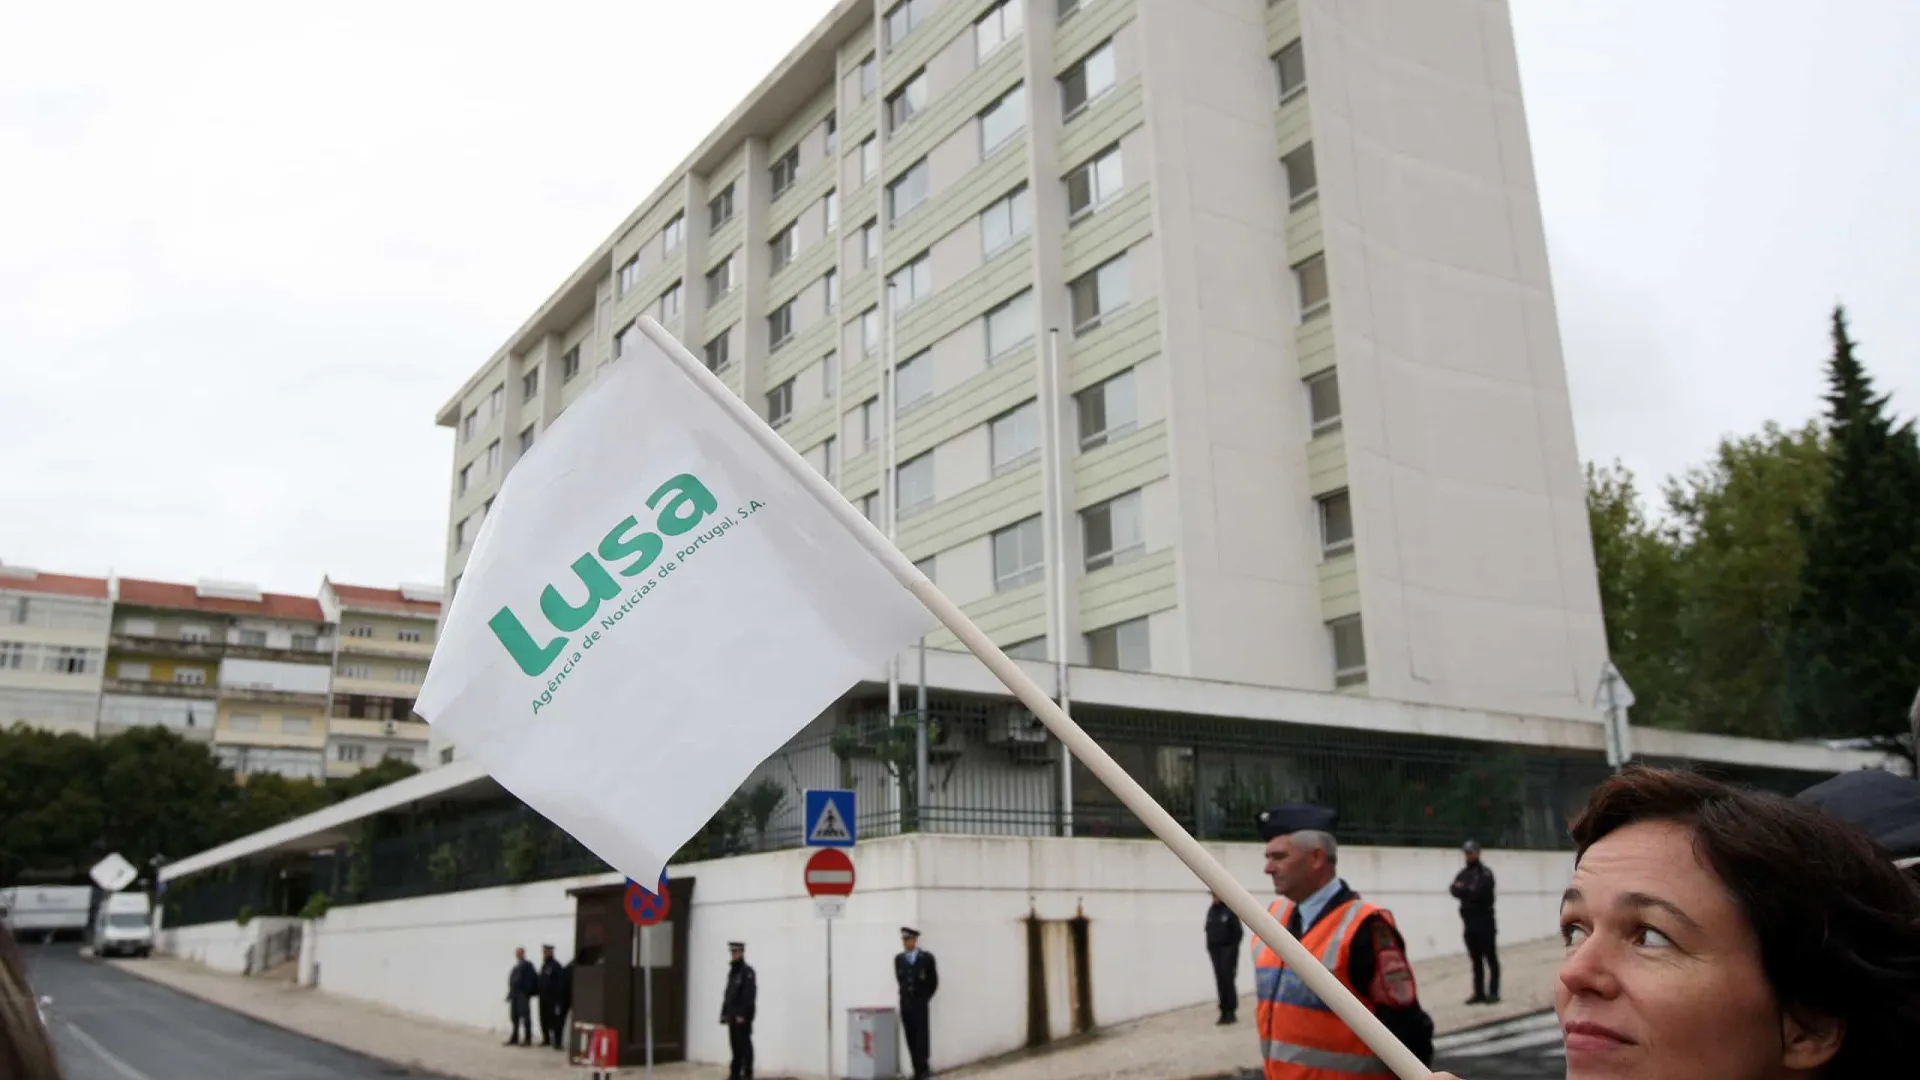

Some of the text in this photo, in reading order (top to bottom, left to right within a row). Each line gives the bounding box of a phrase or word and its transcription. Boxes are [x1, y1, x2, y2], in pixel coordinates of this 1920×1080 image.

[488, 473, 718, 677] Lusa
[531, 651, 582, 715] Agência
[582, 631, 601, 649] de
[658, 561, 677, 578] de
[676, 516, 739, 562] Portugal,
[737, 500, 766, 519] S.A.
